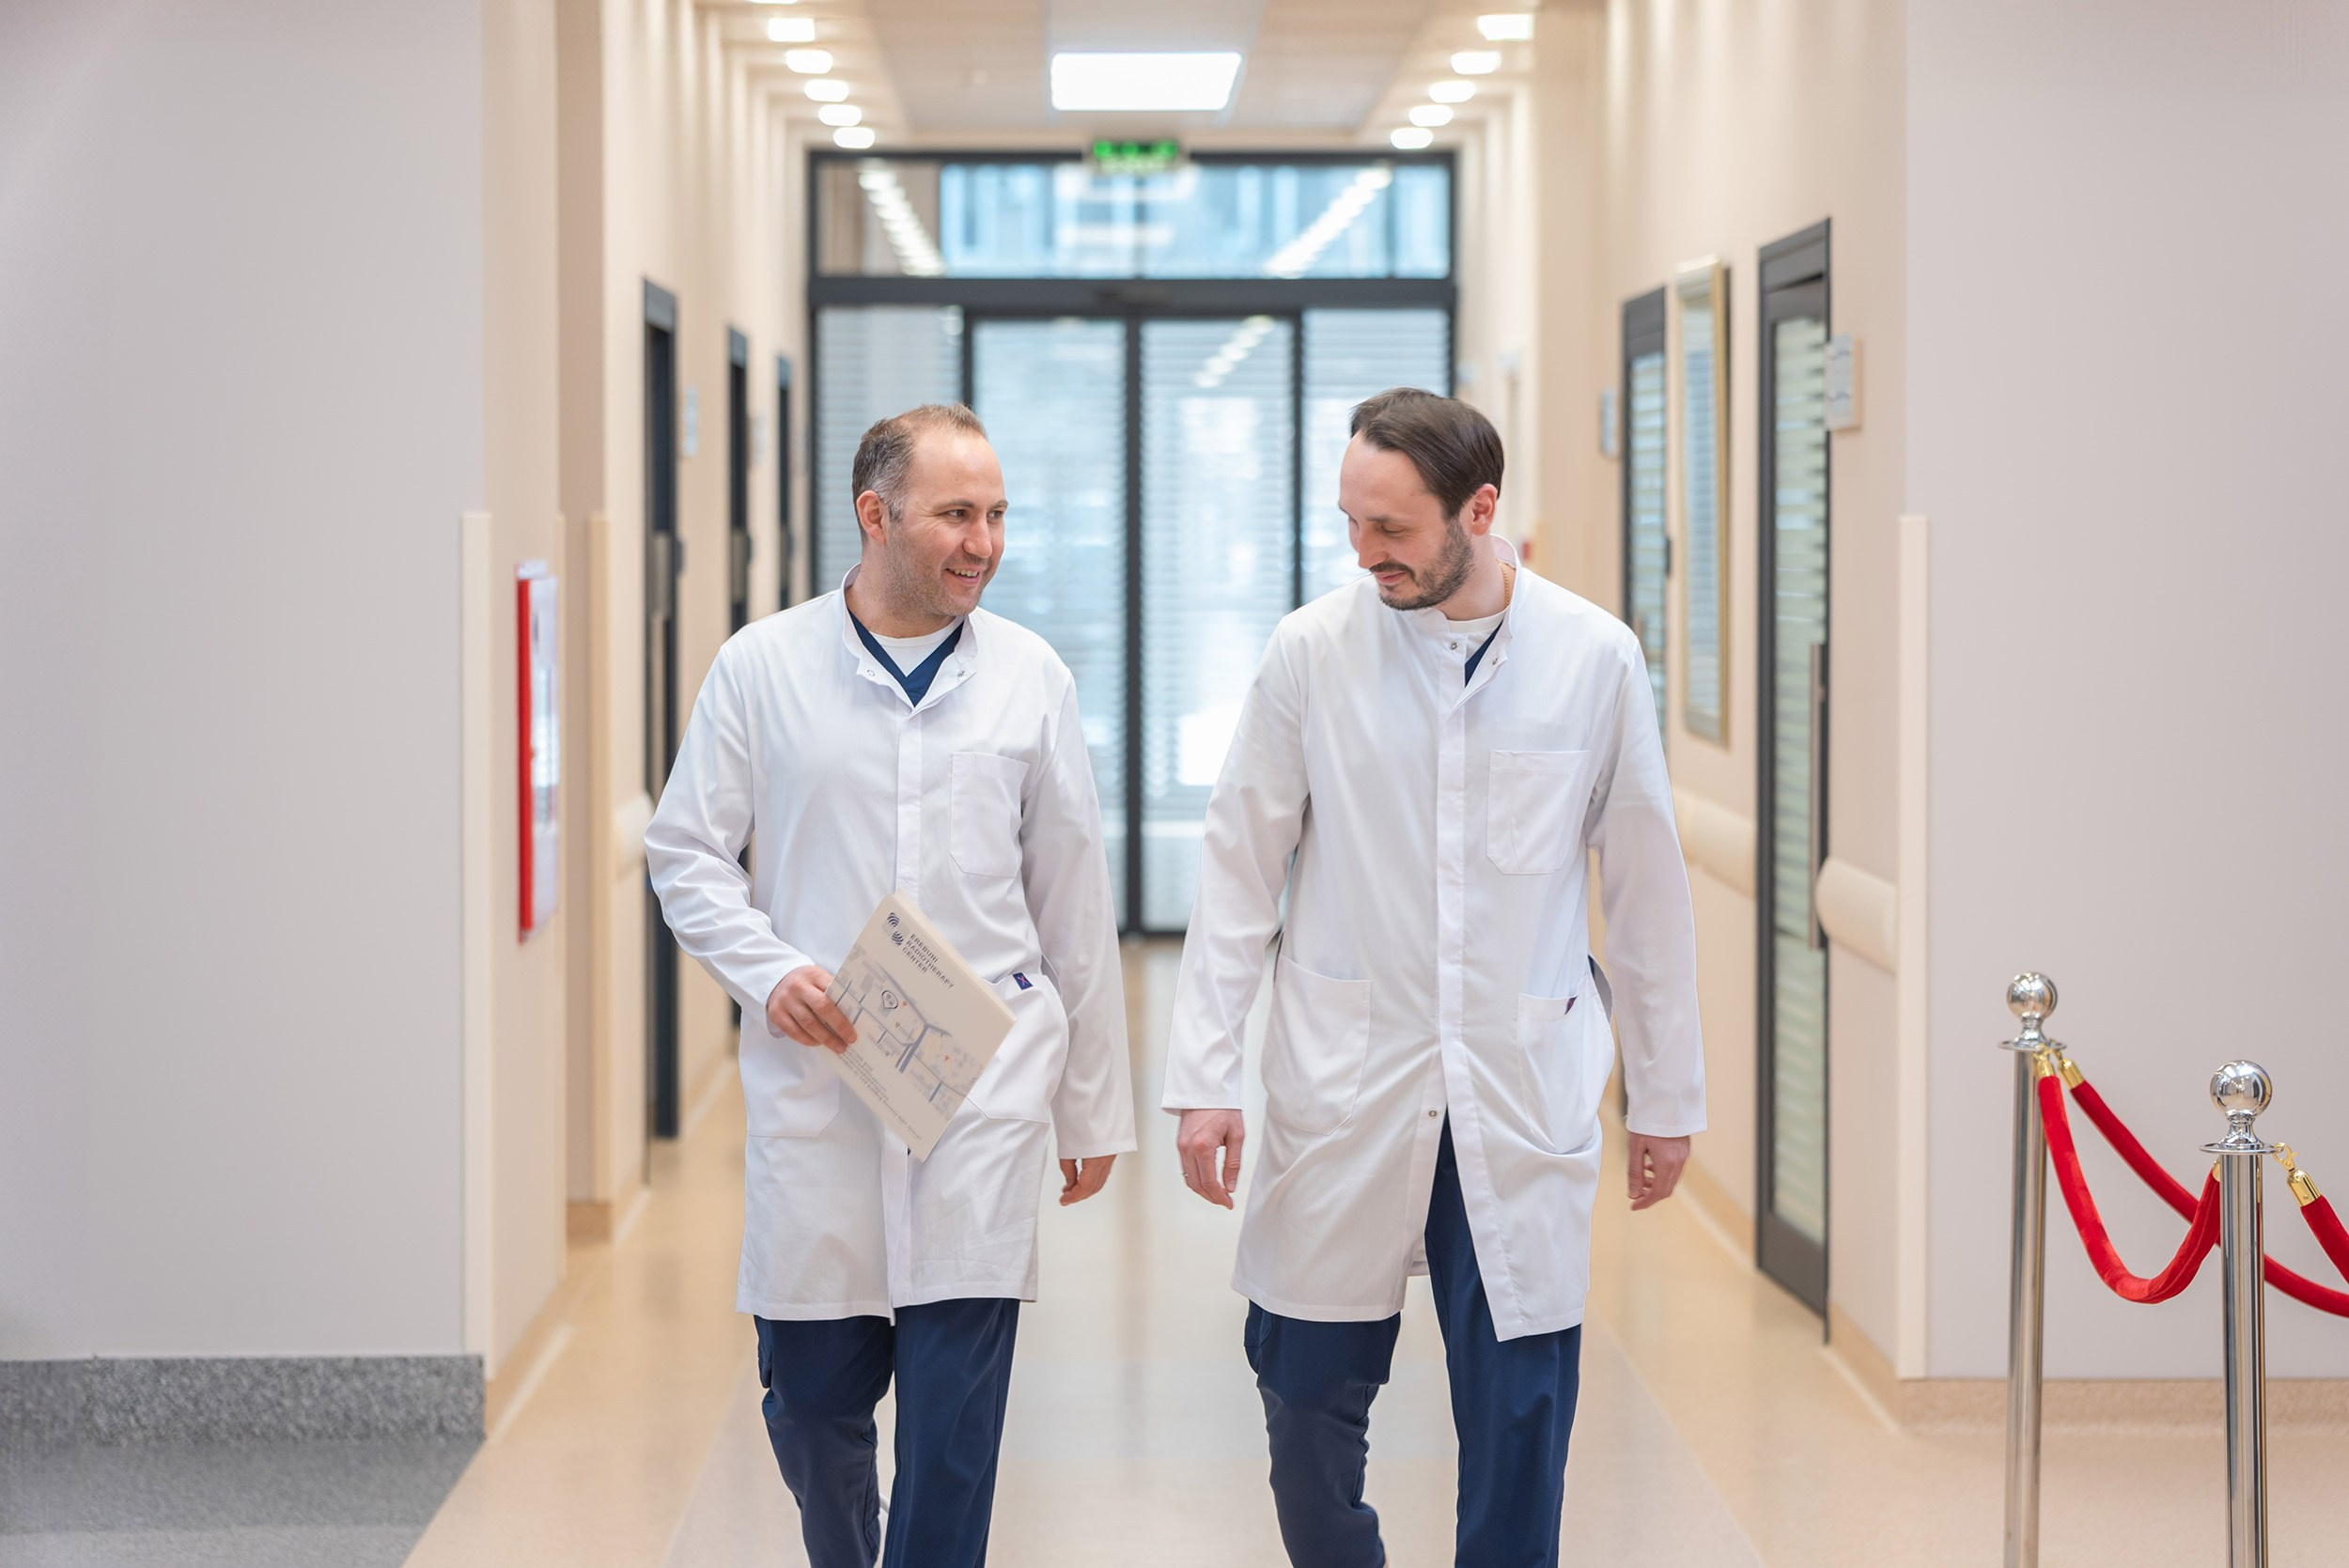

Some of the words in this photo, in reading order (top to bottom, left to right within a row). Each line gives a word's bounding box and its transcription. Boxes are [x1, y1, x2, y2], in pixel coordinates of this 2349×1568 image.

[902, 947, 928, 972] CENTER
[910, 934, 938, 963] EREBUNI
[907, 940, 954, 987] RADIOTHERAPY
